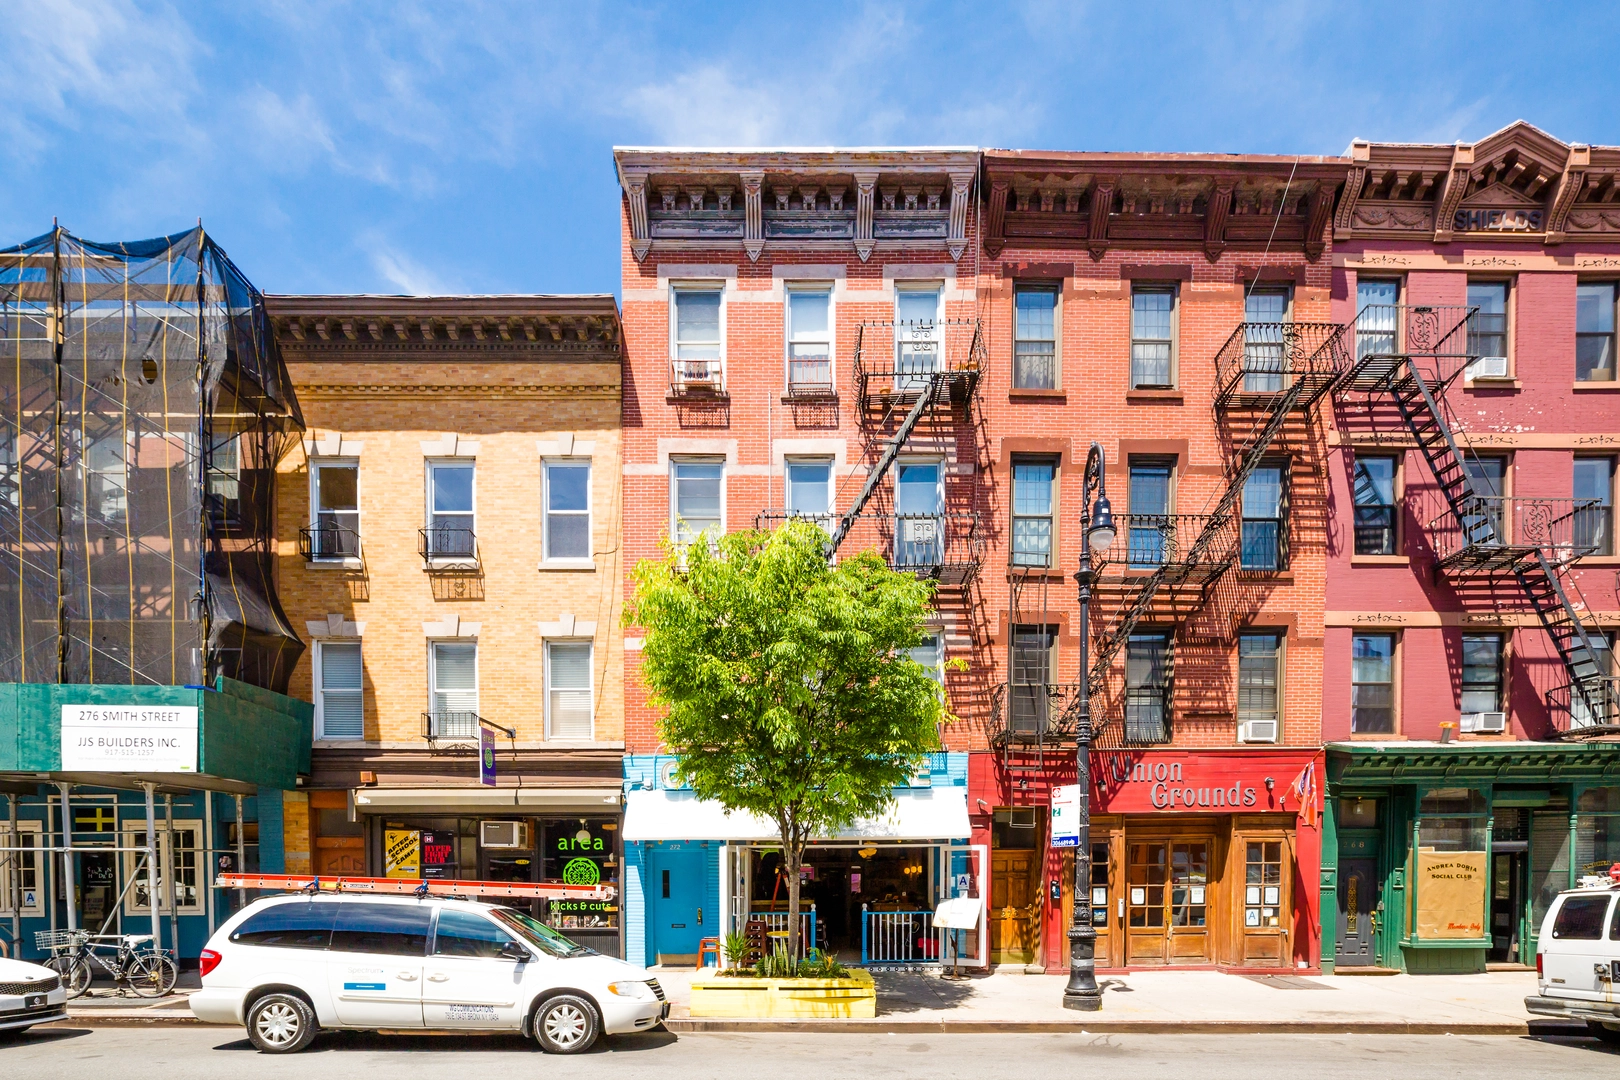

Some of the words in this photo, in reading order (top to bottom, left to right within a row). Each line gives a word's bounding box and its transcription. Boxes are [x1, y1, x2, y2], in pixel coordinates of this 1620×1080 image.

[1455, 210, 1542, 229] SHIELDS
[79, 711, 99, 721] 276
[102, 711, 138, 721] SMITH
[141, 711, 181, 722] STREET
[78, 737, 94, 747] JJS
[98, 737, 154, 748] BUILDERS
[157, 738, 181, 748] INC.
[1109, 755, 1183, 782] Union
[1150, 781, 1257, 809] Grounds
[388, 836, 409, 854] AFTER
[391, 837, 418, 858] SCHOOL
[558, 837, 604, 851] area
[1343, 841, 1365, 849] 268
[395, 848, 415, 865] CAMP
[1427, 863, 1454, 872] ANDREA
[1456, 863, 1477, 872] DORIA
[959, 876, 967, 886] A
[26, 892, 35, 902] A
[550, 902, 578, 911] kicks
[580, 902, 587, 911] &
[589, 902, 611, 911] cuts
[1248, 911, 1256, 920] A
[347, 966, 383, 975] Spectrum
